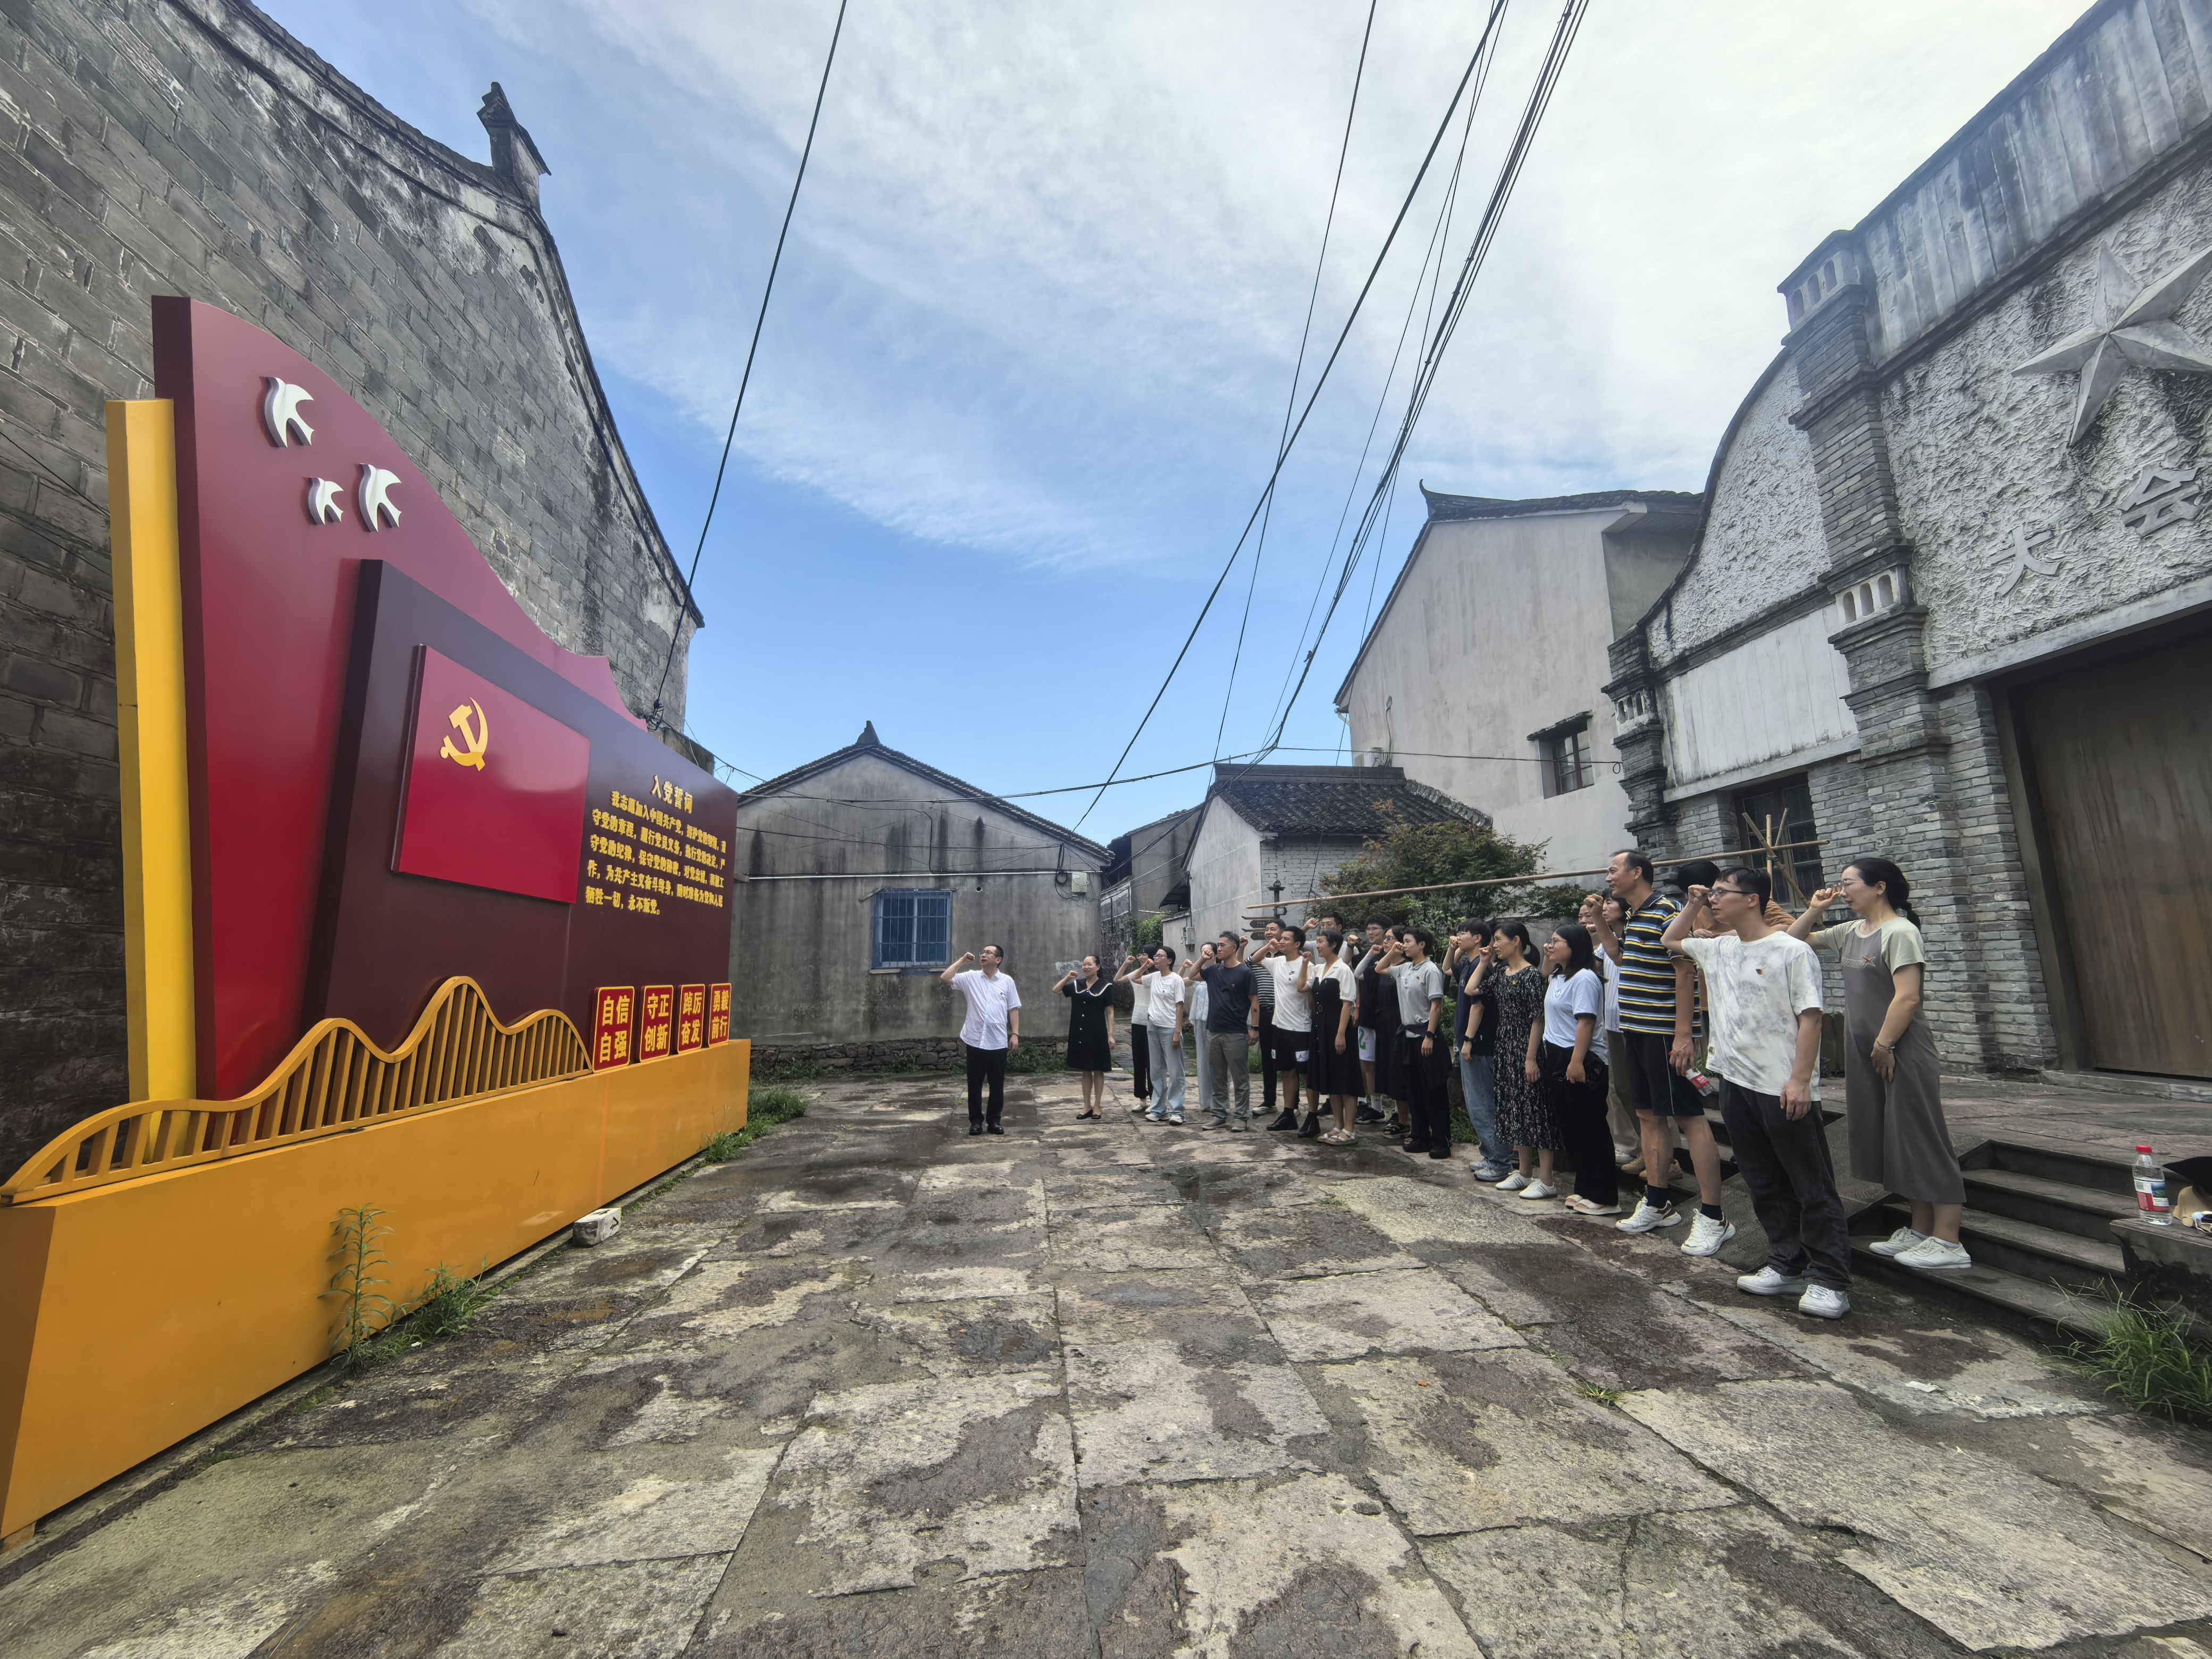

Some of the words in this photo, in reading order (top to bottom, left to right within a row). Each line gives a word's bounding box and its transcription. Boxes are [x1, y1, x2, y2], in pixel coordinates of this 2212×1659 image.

[650, 774, 693, 814] 入党誓词
[602, 995, 630, 1026] 自信
[647, 993, 669, 1019] 守正
[683, 992, 702, 1016] 踔厉
[713, 990, 729, 1012] 勇毅
[644, 1024, 668, 1052] 创新
[681, 1020, 700, 1045] 奋发
[712, 1015, 728, 1040] 前行
[600, 1030, 627, 1063] 自强
